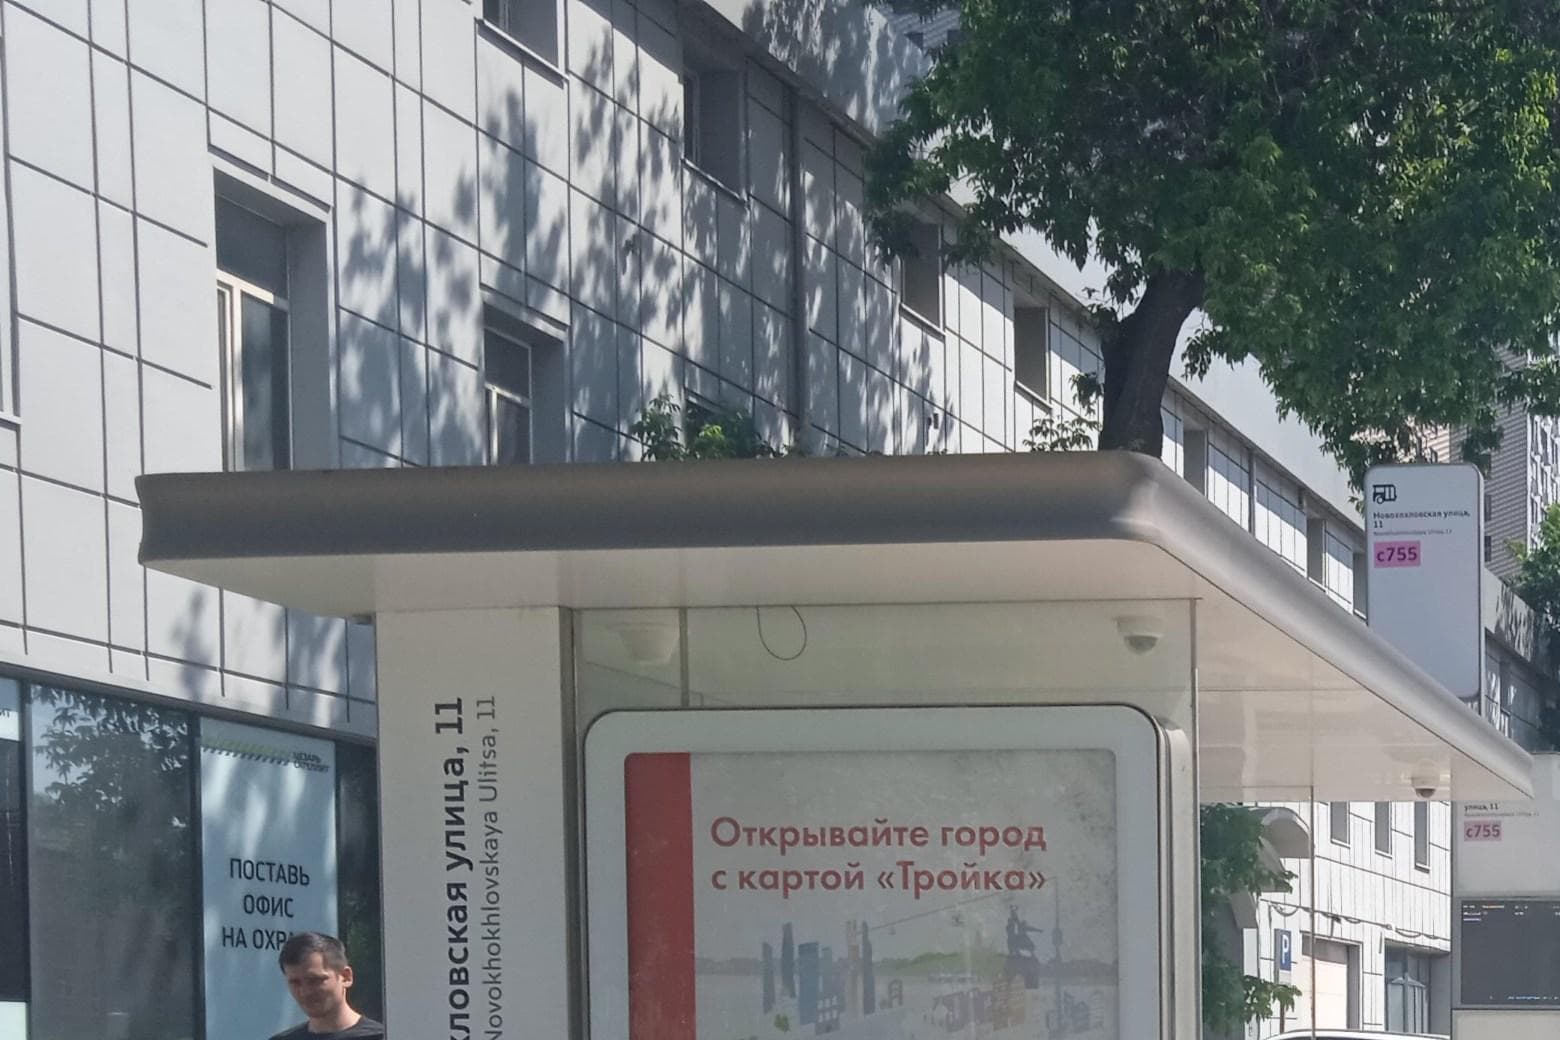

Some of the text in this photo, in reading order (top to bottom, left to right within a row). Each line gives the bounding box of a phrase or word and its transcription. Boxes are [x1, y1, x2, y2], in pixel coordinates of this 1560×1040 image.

[1376, 547, 1418, 562] с755
[435, 697, 463, 734] 11
[476, 696, 496, 719] 11
[478, 728, 500, 802] Ulitsa,
[443, 747, 474, 871] улица,
[710, 816, 1047, 856] Открывайте город
[1466, 825, 1500, 838] с755
[230, 858, 310, 886] ПОСТАВЬ
[711, 860, 1046, 899] с картой «Тройка»
[243, 894, 294, 918] ОФИС
[222, 927, 292, 951] НА ОХР
[1282, 934, 1289, 964] P
